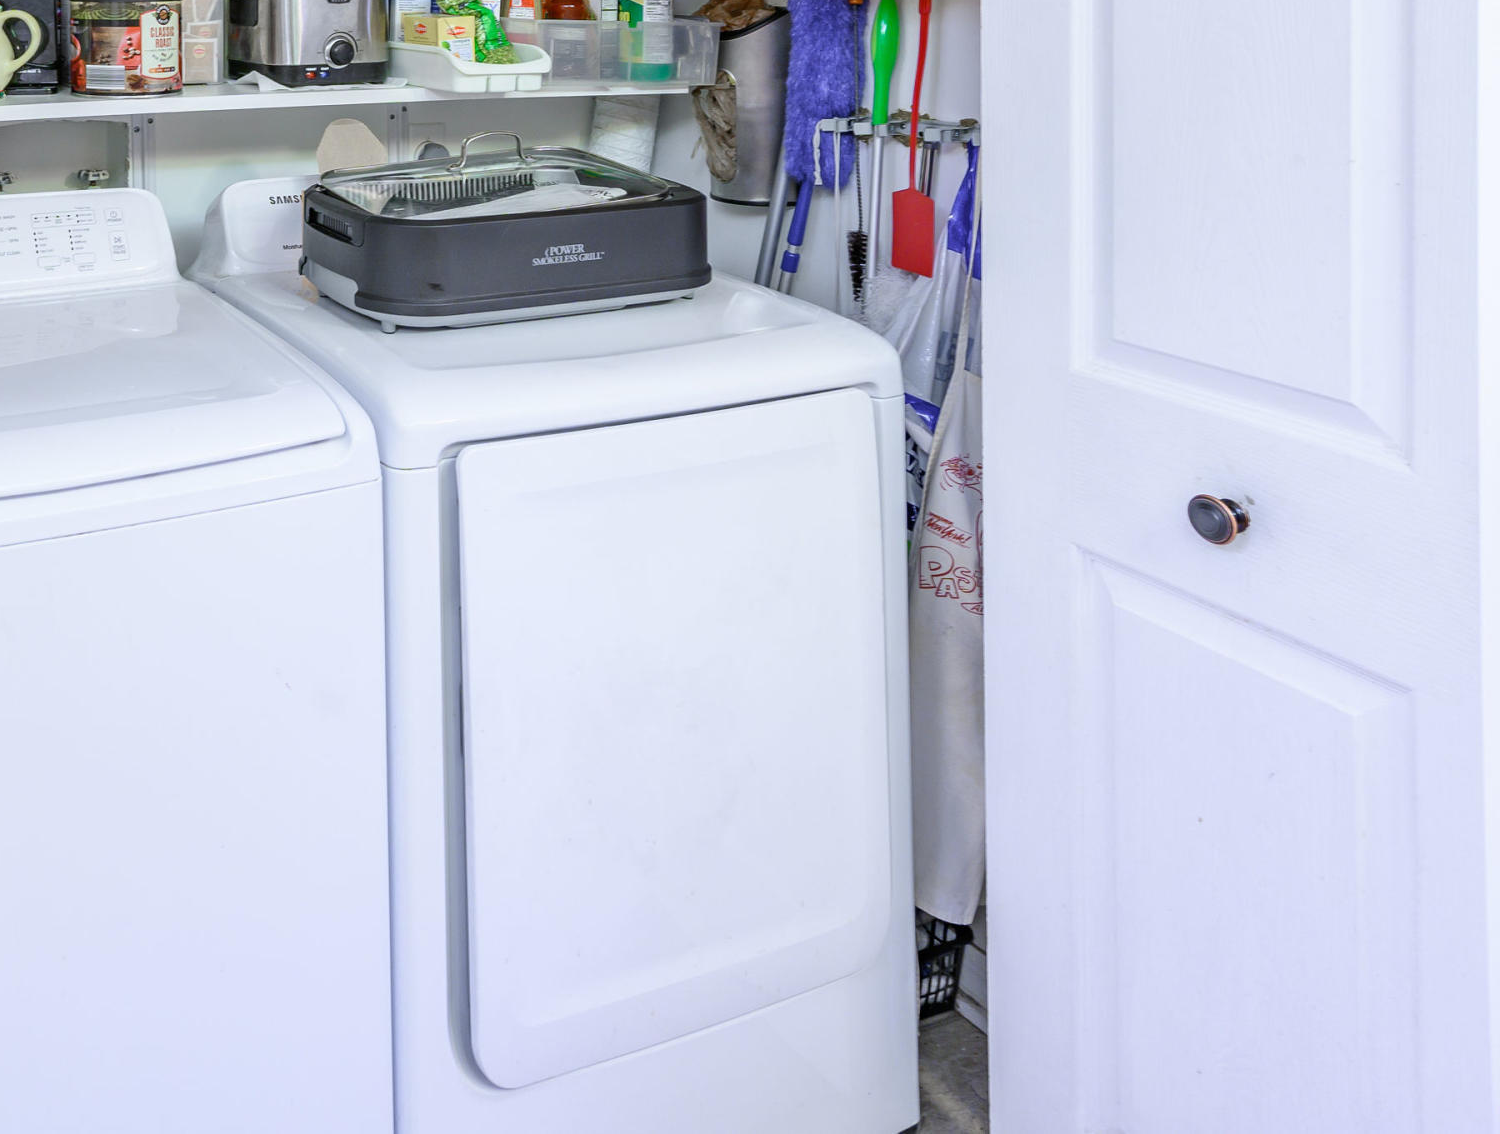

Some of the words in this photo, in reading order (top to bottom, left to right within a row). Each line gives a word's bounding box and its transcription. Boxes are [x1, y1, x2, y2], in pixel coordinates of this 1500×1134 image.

[269, 195, 303, 205] SAMS
[549, 243, 585, 256] POWER
[532, 254, 578, 266] SMOKELESS
[578, 252, 603, 262] GRILL
